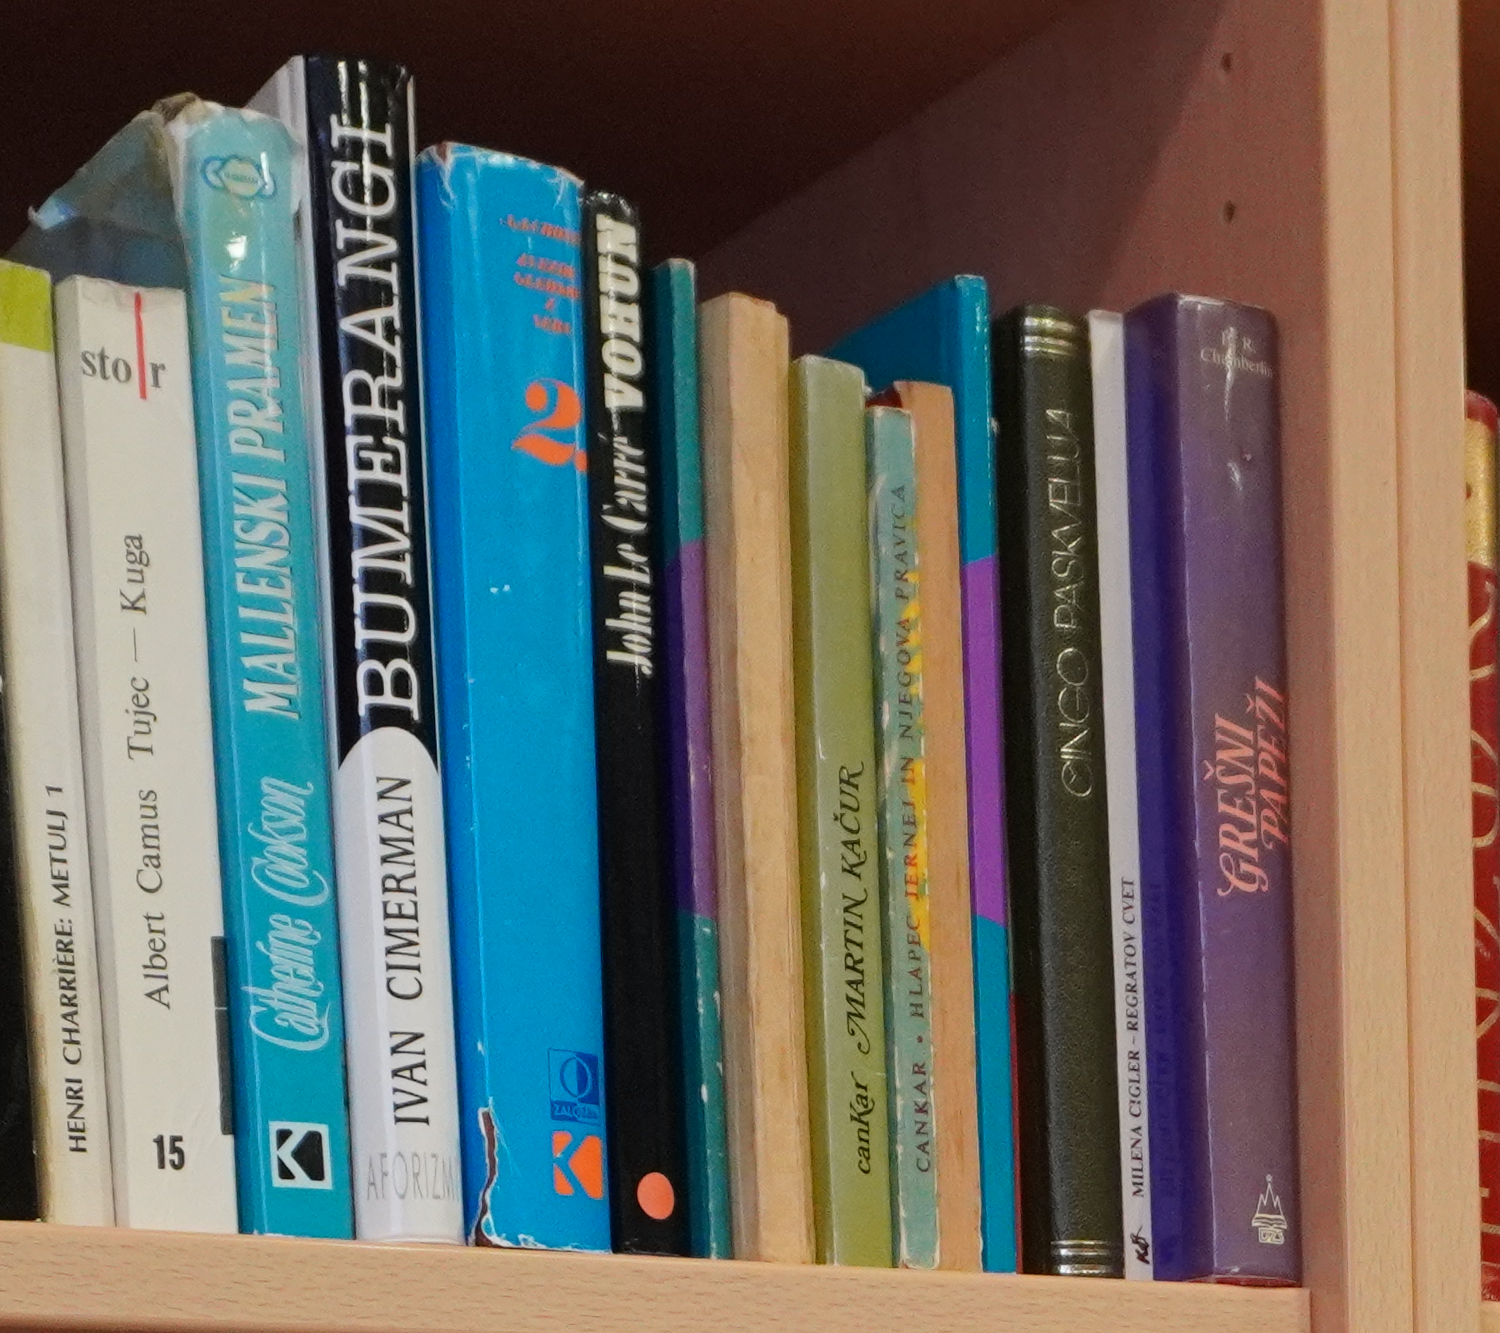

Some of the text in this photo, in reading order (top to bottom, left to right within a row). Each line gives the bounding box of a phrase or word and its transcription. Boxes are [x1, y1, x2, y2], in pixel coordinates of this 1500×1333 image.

[220, 274, 299, 719] MALLENSKI PRAMEN
[328, 112, 420, 723] BUMERANGI
[593, 213, 655, 677] John Le Carré VOHUN
[43, 782, 90, 1155] HENRI CHARRIÈRE: METULJ 1
[373, 772, 430, 1129] IVAN CIMERMAN
[1203, 713, 1271, 896] GREŠNI
